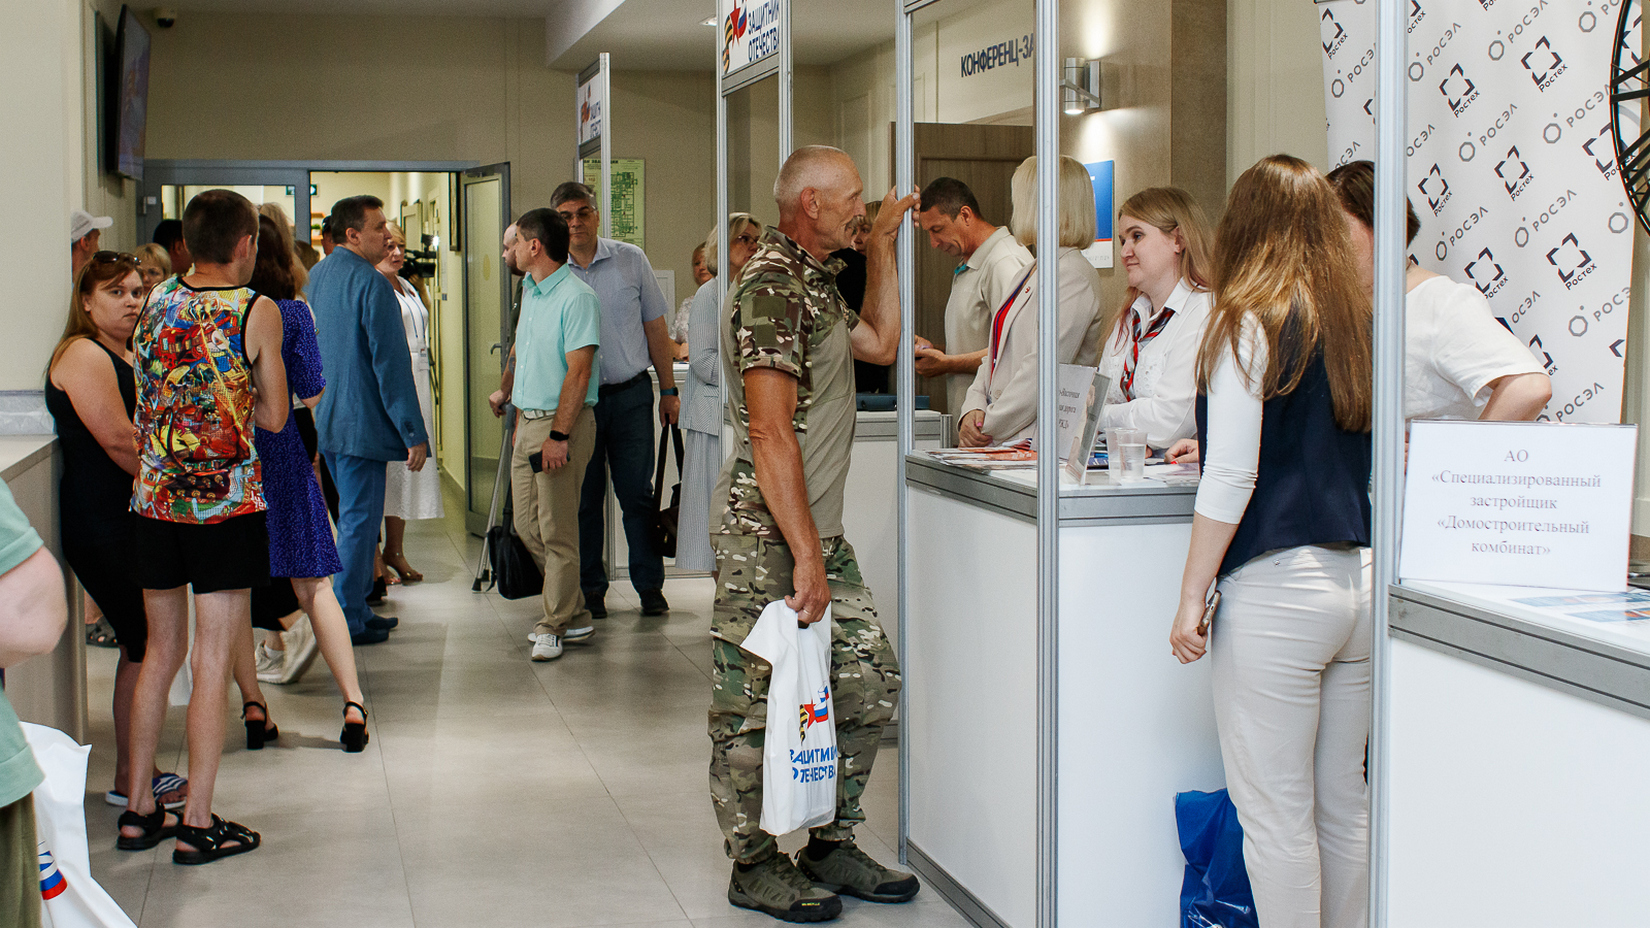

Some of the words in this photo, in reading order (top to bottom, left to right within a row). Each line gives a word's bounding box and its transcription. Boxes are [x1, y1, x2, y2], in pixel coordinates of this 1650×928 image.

[1407, 11, 1426, 34] остех
[1328, 33, 1348, 60] Ростех
[1427, 22, 1461, 65] РОСЭЛ
[1347, 43, 1376, 83] РОСЭ
[1538, 63, 1568, 93] Ростех
[1453, 90, 1480, 118] Ростех
[1479, 103, 1518, 146] РОСЭЛ
[1406, 124, 1435, 157] ОСЭЛ
[1335, 141, 1361, 169] ОСЭЛ
[1510, 173, 1534, 202] Ростех
[1433, 191, 1453, 217] Ростех
[1532, 189, 1577, 232] РОСЭЛ
[1449, 206, 1488, 246] РОСЭЛ
[1565, 262, 1597, 290] Ростех
[1511, 290, 1541, 324] ОСЭЛ
[1556, 382, 1604, 422] РОСЭЛ
[1504, 449, 1529, 462] АО
[1431, 470, 1601, 489] «Специализированный
[1470, 496, 1557, 511] застройщик
[1437, 515, 1590, 534] «Домостроительный
[1471, 540, 1551, 556] комбинат»
